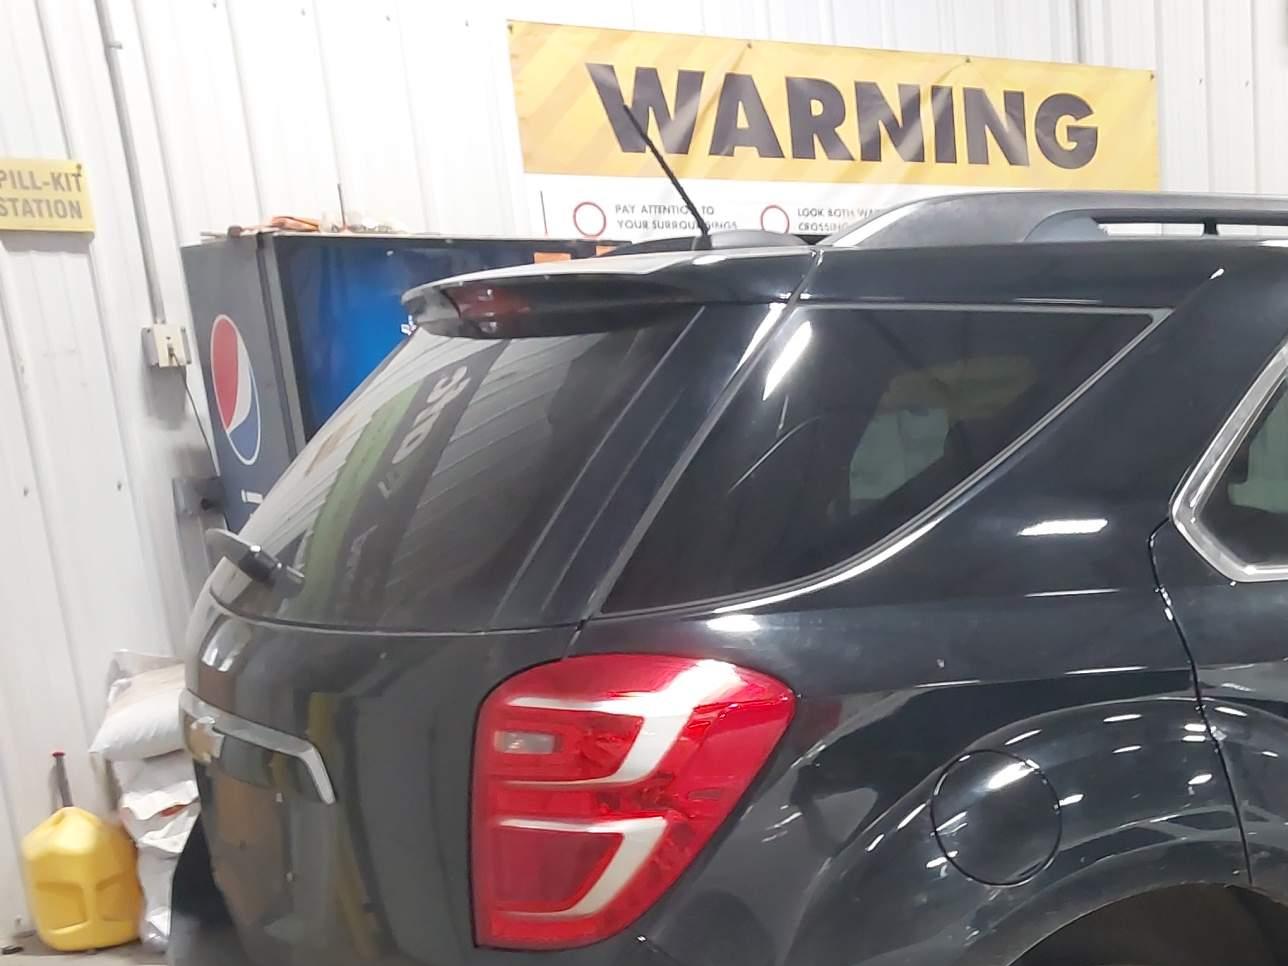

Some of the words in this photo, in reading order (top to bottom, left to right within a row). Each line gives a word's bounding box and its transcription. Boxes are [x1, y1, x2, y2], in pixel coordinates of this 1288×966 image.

[586, 63, 1099, 169] WARNING
[0, 196, 83, 219] STATION
[615, 204, 635, 214] PAY
[640, 204, 697, 215] ATTENTIO
[701, 205, 715, 216] TO
[797, 207, 824, 217] LOOK
[617, 219, 648, 230] YOUR
[652, 219, 738, 231] SURROUINGS
